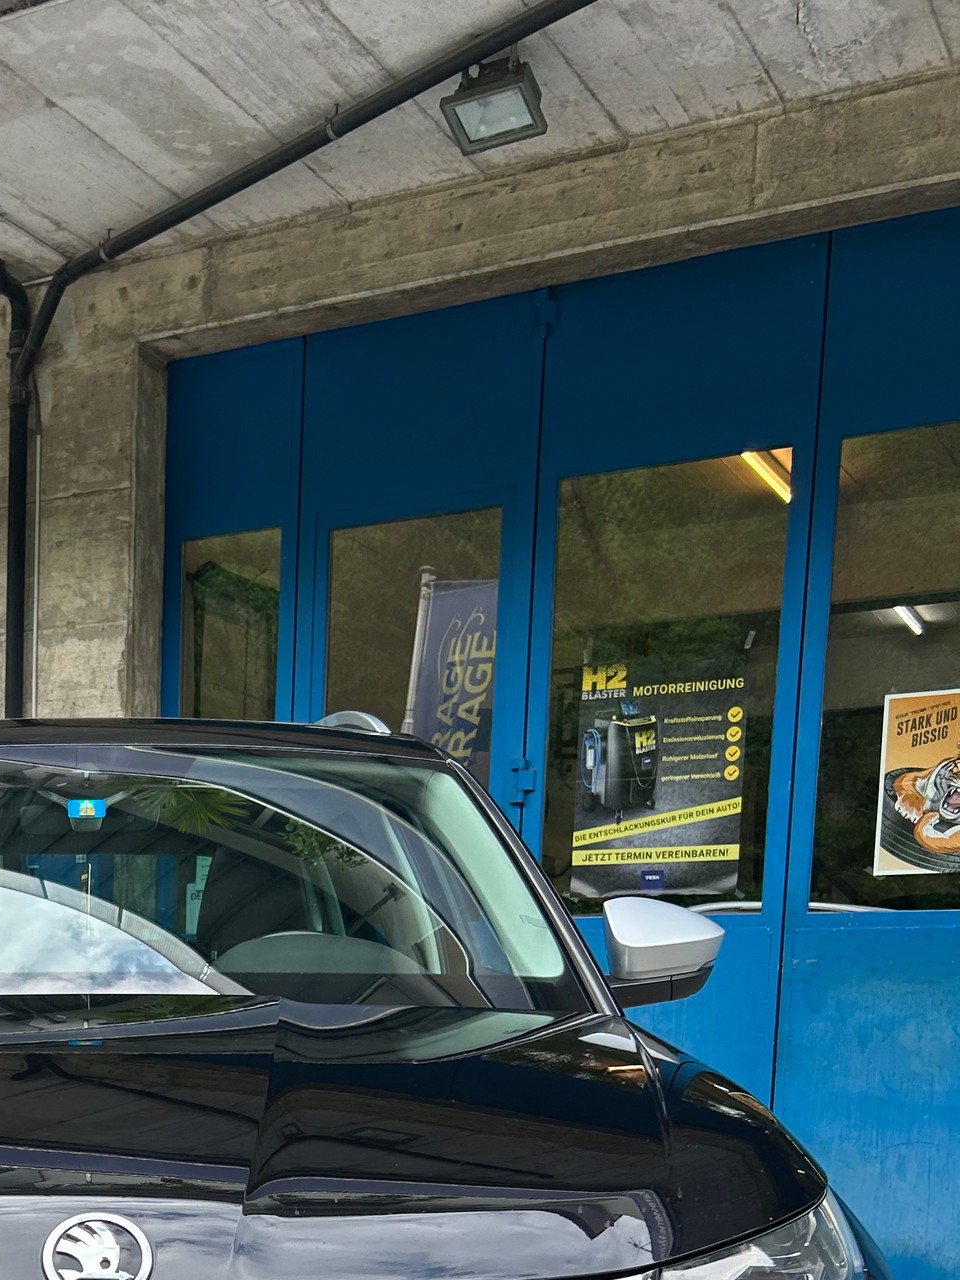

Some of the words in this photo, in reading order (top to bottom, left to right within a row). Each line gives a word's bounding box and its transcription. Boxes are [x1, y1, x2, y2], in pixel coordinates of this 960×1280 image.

[581, 663, 628, 692] H2
[632, 677, 745, 698] MOTORREINIGUNG
[581, 688, 627, 701] BLASTER
[896, 713, 933, 736] STARK
[935, 706, 958, 726] UND
[634, 729, 656, 747] H2
[911, 725, 949, 748] BISSIG
[574, 833, 588, 843] DIE
[588, 815, 677, 840] ENTSCHLACKUNGSKUR
[678, 811, 695, 822] FÜR
[695, 808, 715, 819] DEIN
[715, 801, 741, 815] AUTO!
[581, 852, 614, 863] JETZT
[614, 850, 653, 862] TERMIN
[654, 848, 730, 860] VEREINBAREN!
